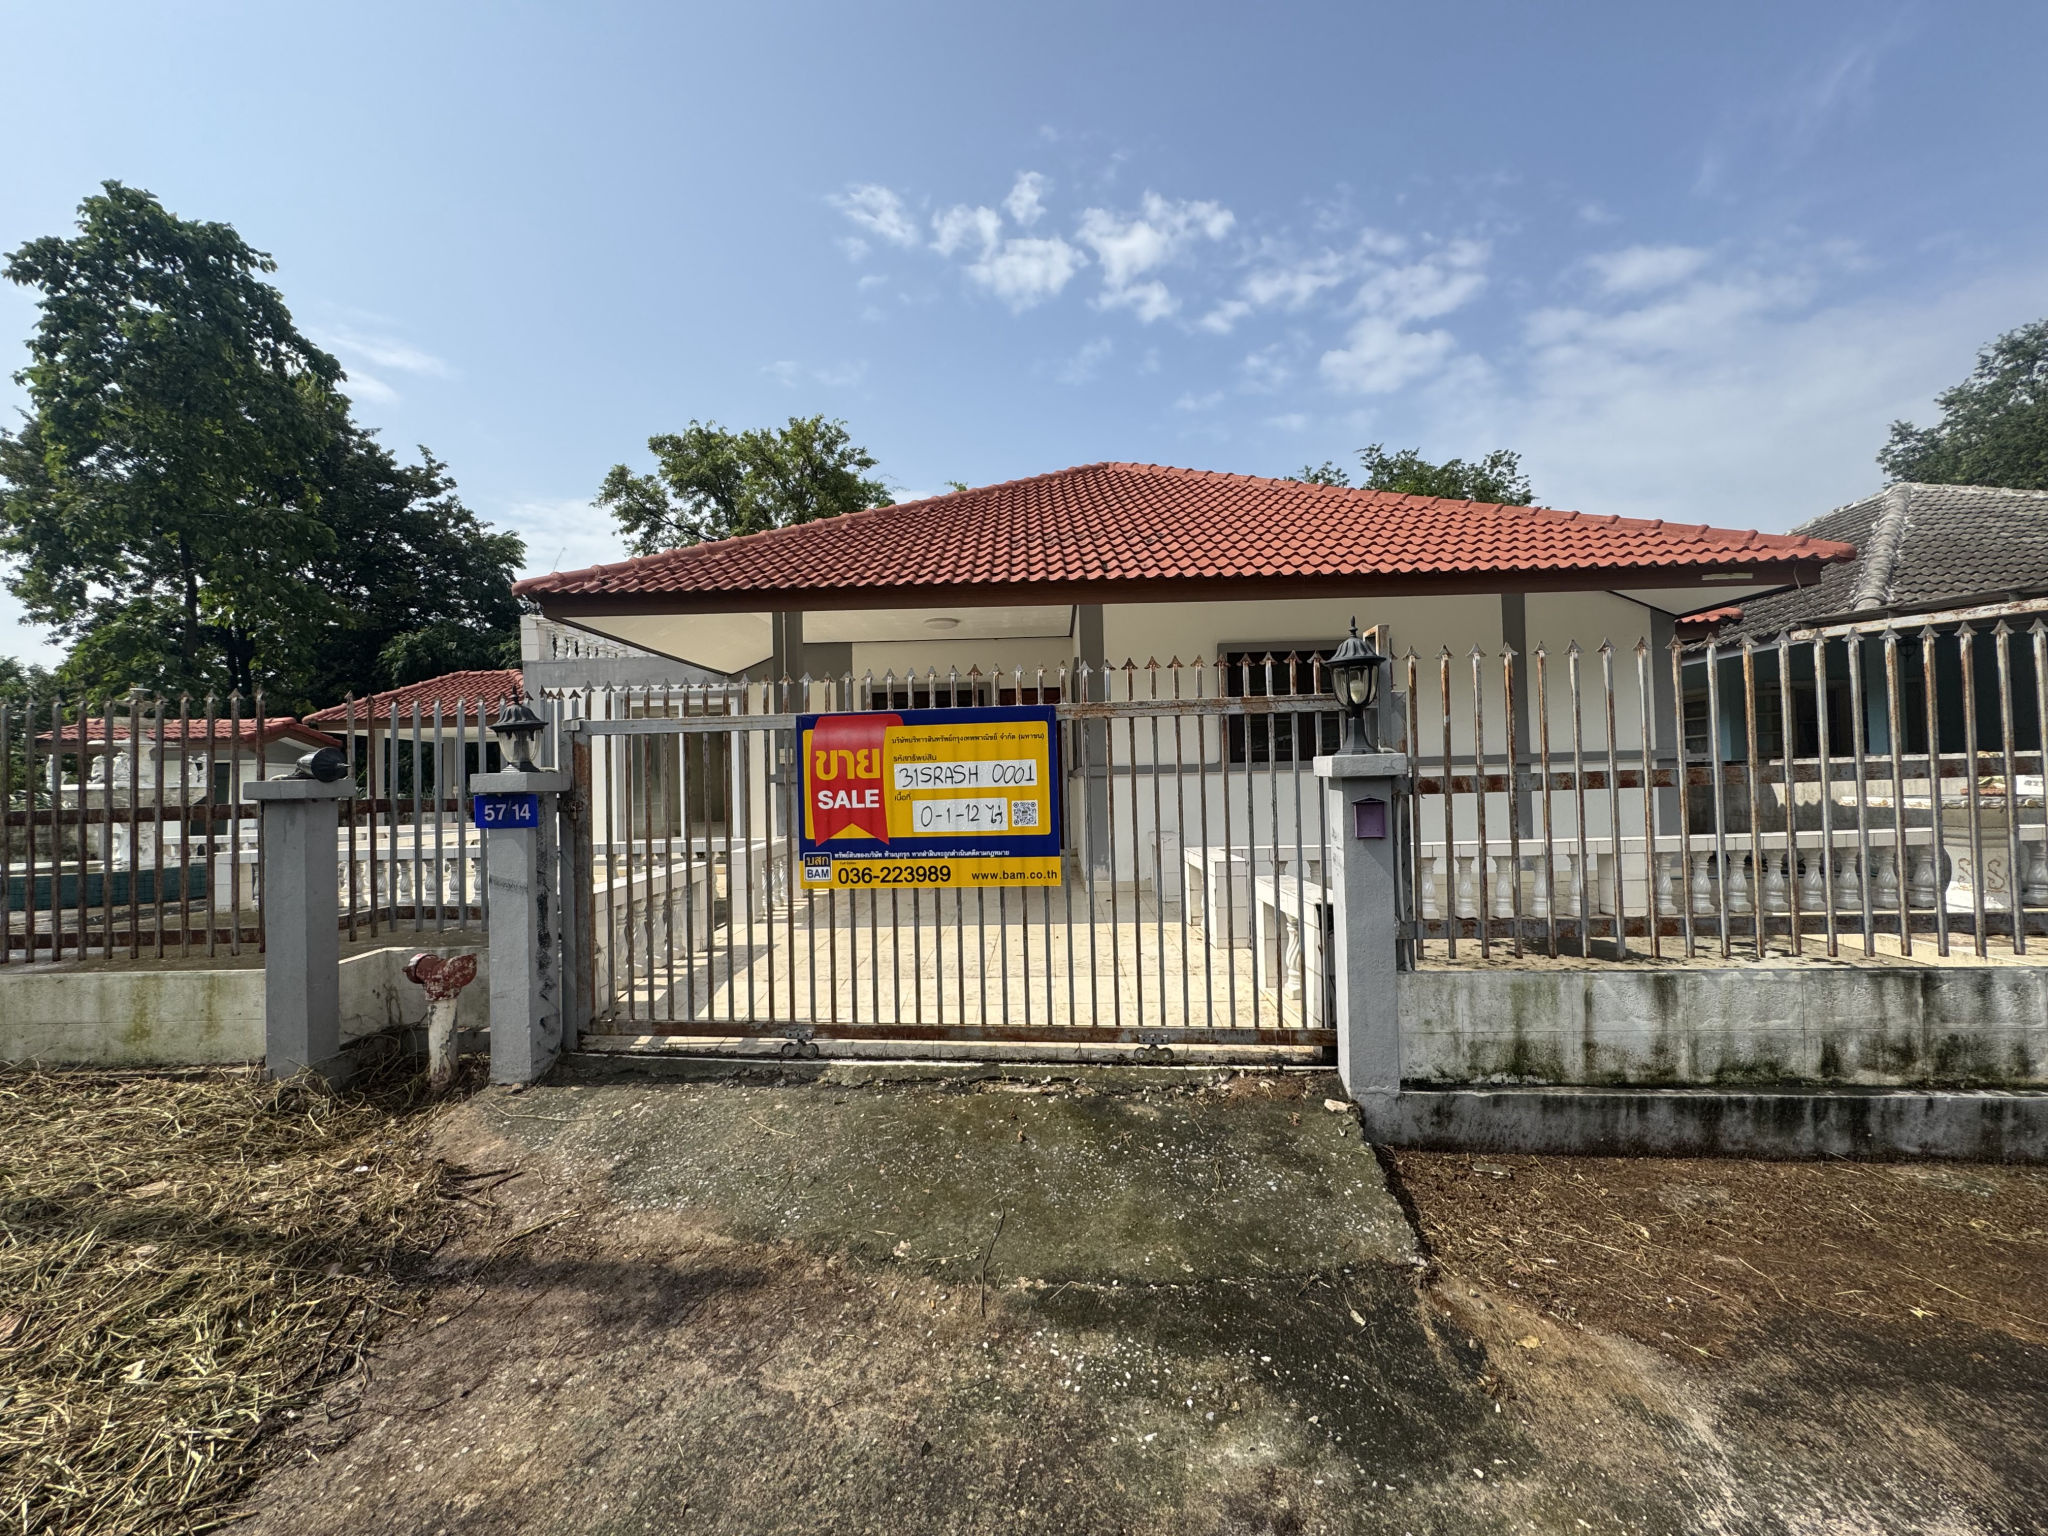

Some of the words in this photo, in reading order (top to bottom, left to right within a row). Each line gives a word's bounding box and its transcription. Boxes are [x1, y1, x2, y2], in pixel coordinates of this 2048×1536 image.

[816, 748, 880, 780] ขาย
[992, 763, 1035, 784] 0001
[817, 789, 880, 810] SALE
[806, 855, 829, 866] บสก
[806, 868, 830, 879] BAM
[838, 865, 951, 884] 036-223989
[971, 869, 1058, 880] www.bam.co.th
